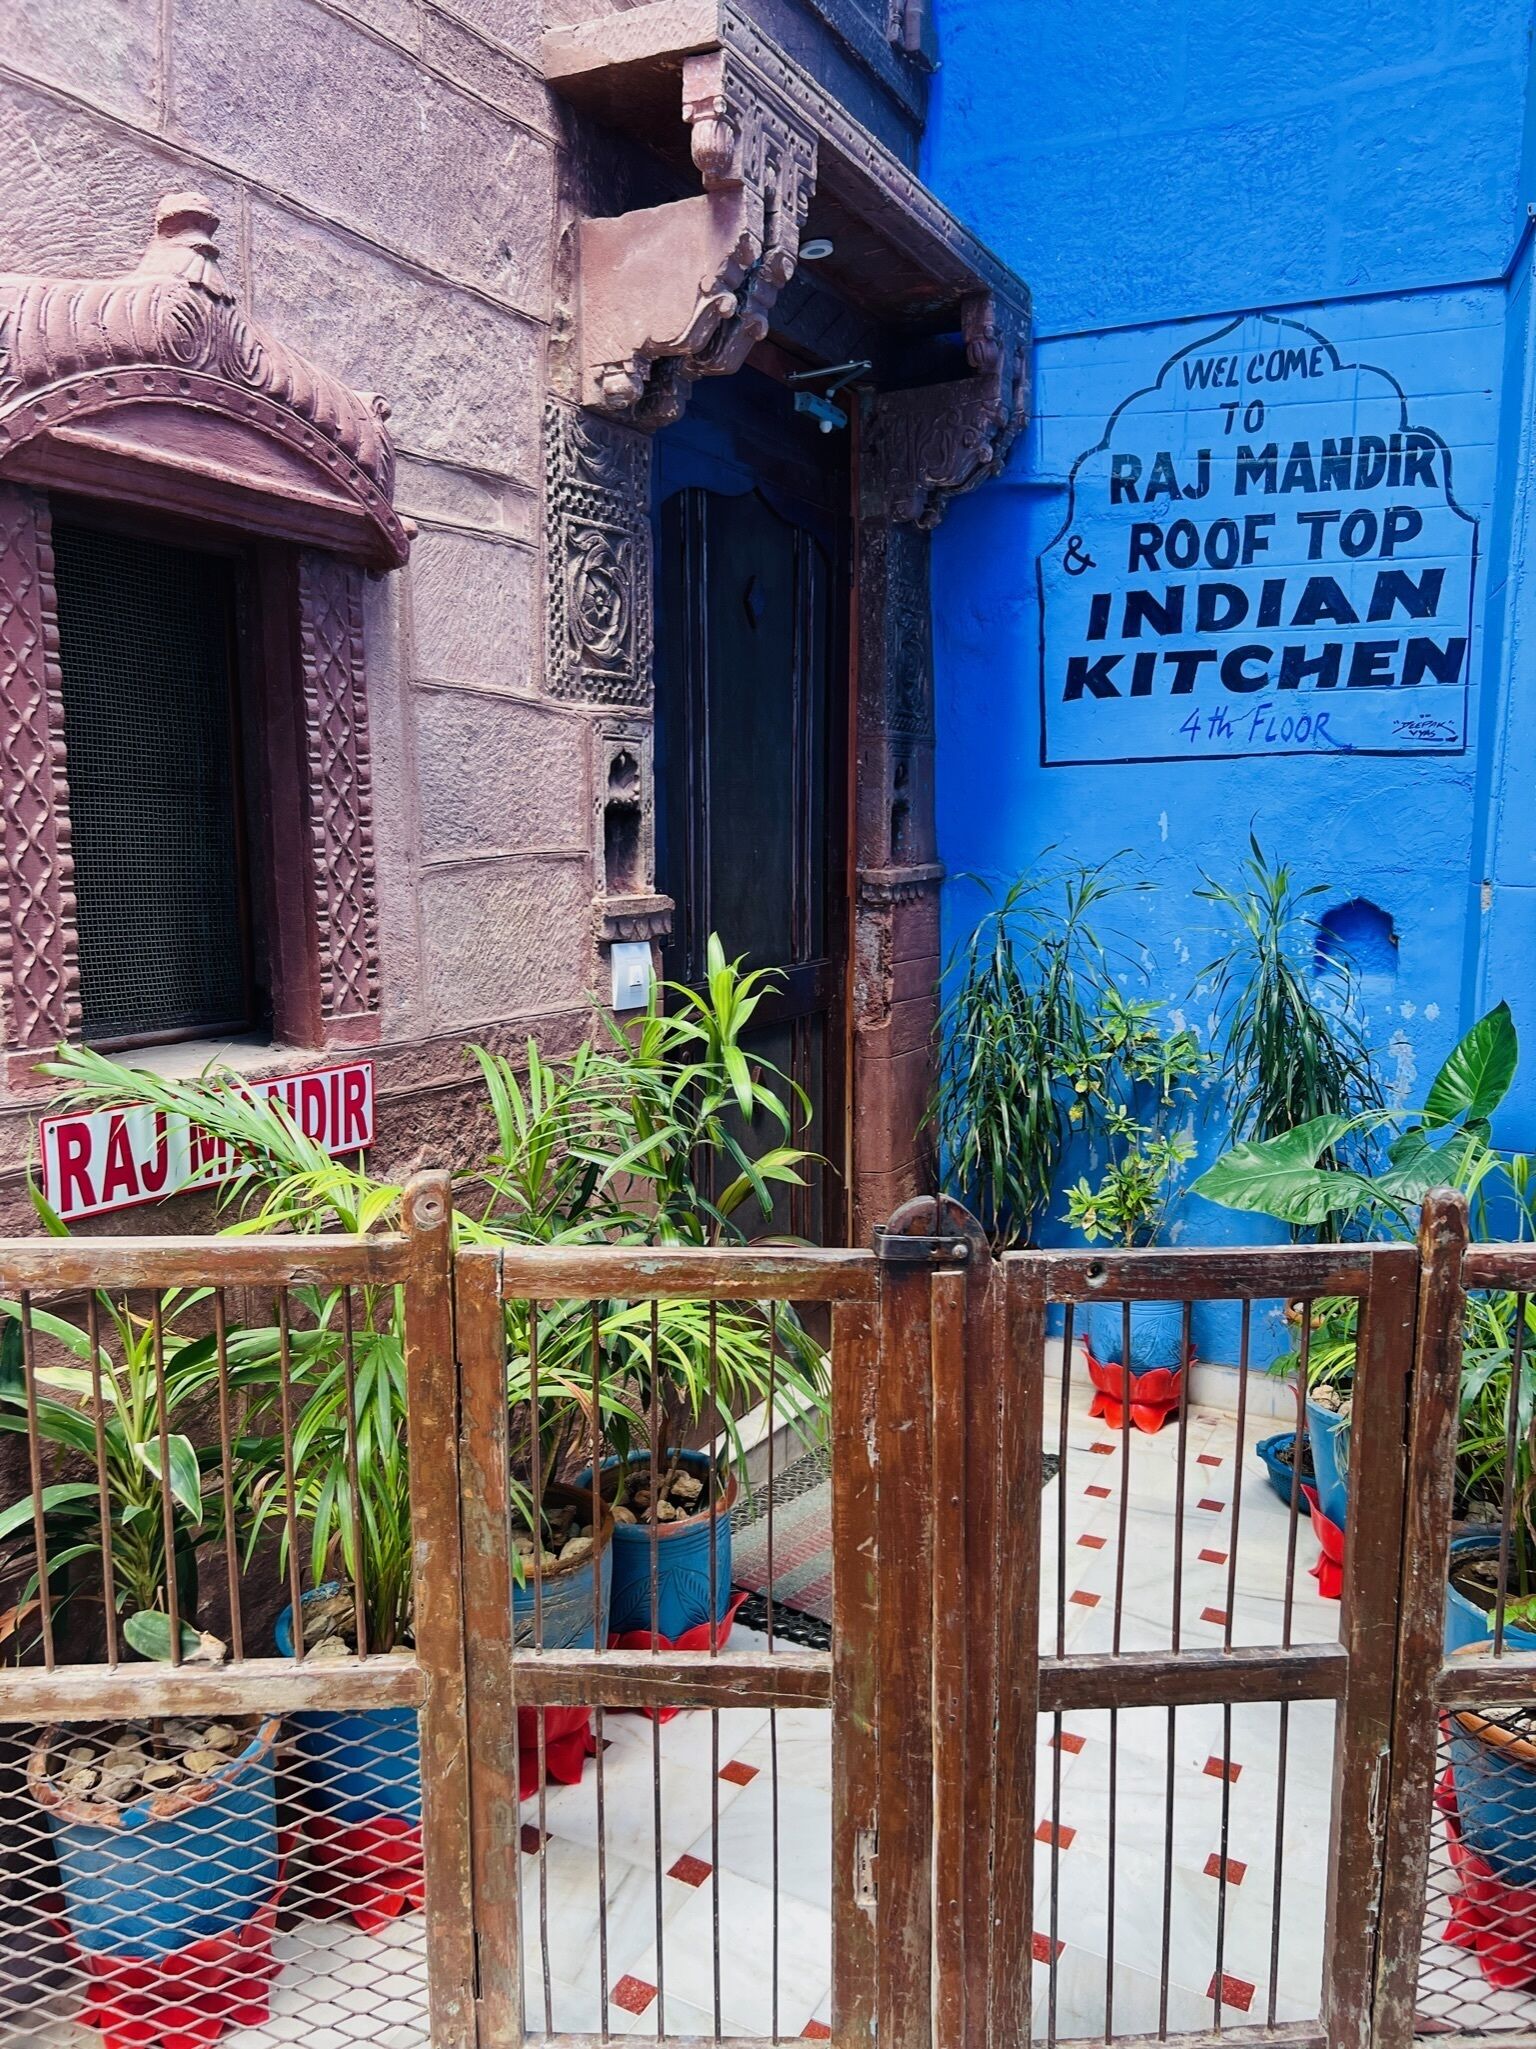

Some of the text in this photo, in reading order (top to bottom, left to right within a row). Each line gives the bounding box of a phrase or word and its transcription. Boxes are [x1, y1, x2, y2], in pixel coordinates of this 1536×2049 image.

[1183, 346, 1324, 390] WELCOME
[1220, 399, 1264, 434] TO
[1110, 433, 1439, 505] RAJ MANDIR
[1063, 505, 1423, 576] & ROOF TOP
[1086, 568, 1446, 641] INDIAN
[1062, 637, 1468, 702] KITCHEN
[1249, 702, 1352, 750] FLOOR
[57, 1107, 168, 1212] RAJ
